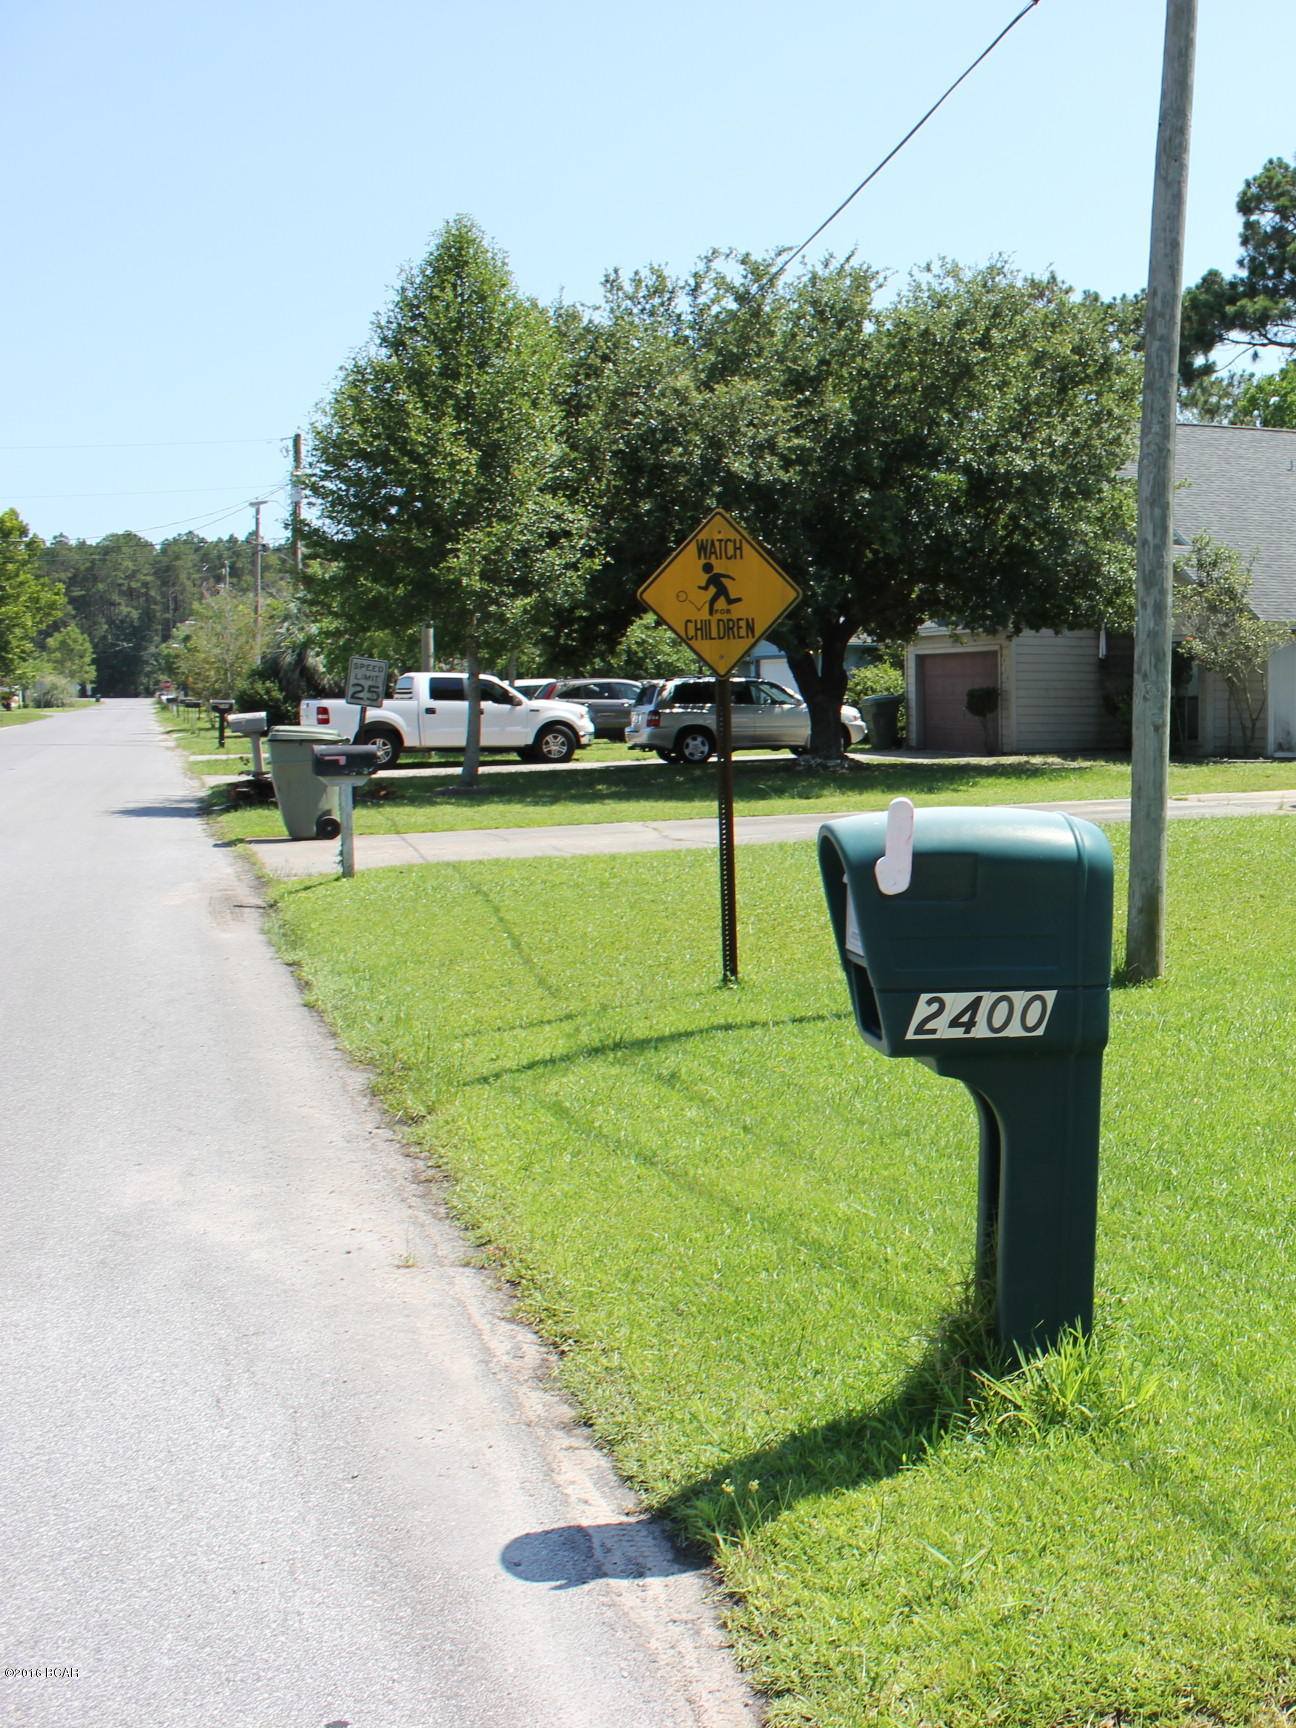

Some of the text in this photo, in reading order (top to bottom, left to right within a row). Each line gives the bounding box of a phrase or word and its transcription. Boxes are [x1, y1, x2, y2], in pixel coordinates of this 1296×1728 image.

[696, 538, 743, 561] WATCH
[684, 617, 756, 641] CHILDREN
[352, 662, 384, 673] SPEED
[354, 673, 380, 682] LIMIT
[350, 682, 381, 702] 25
[912, 993, 1048, 1036] 2400
